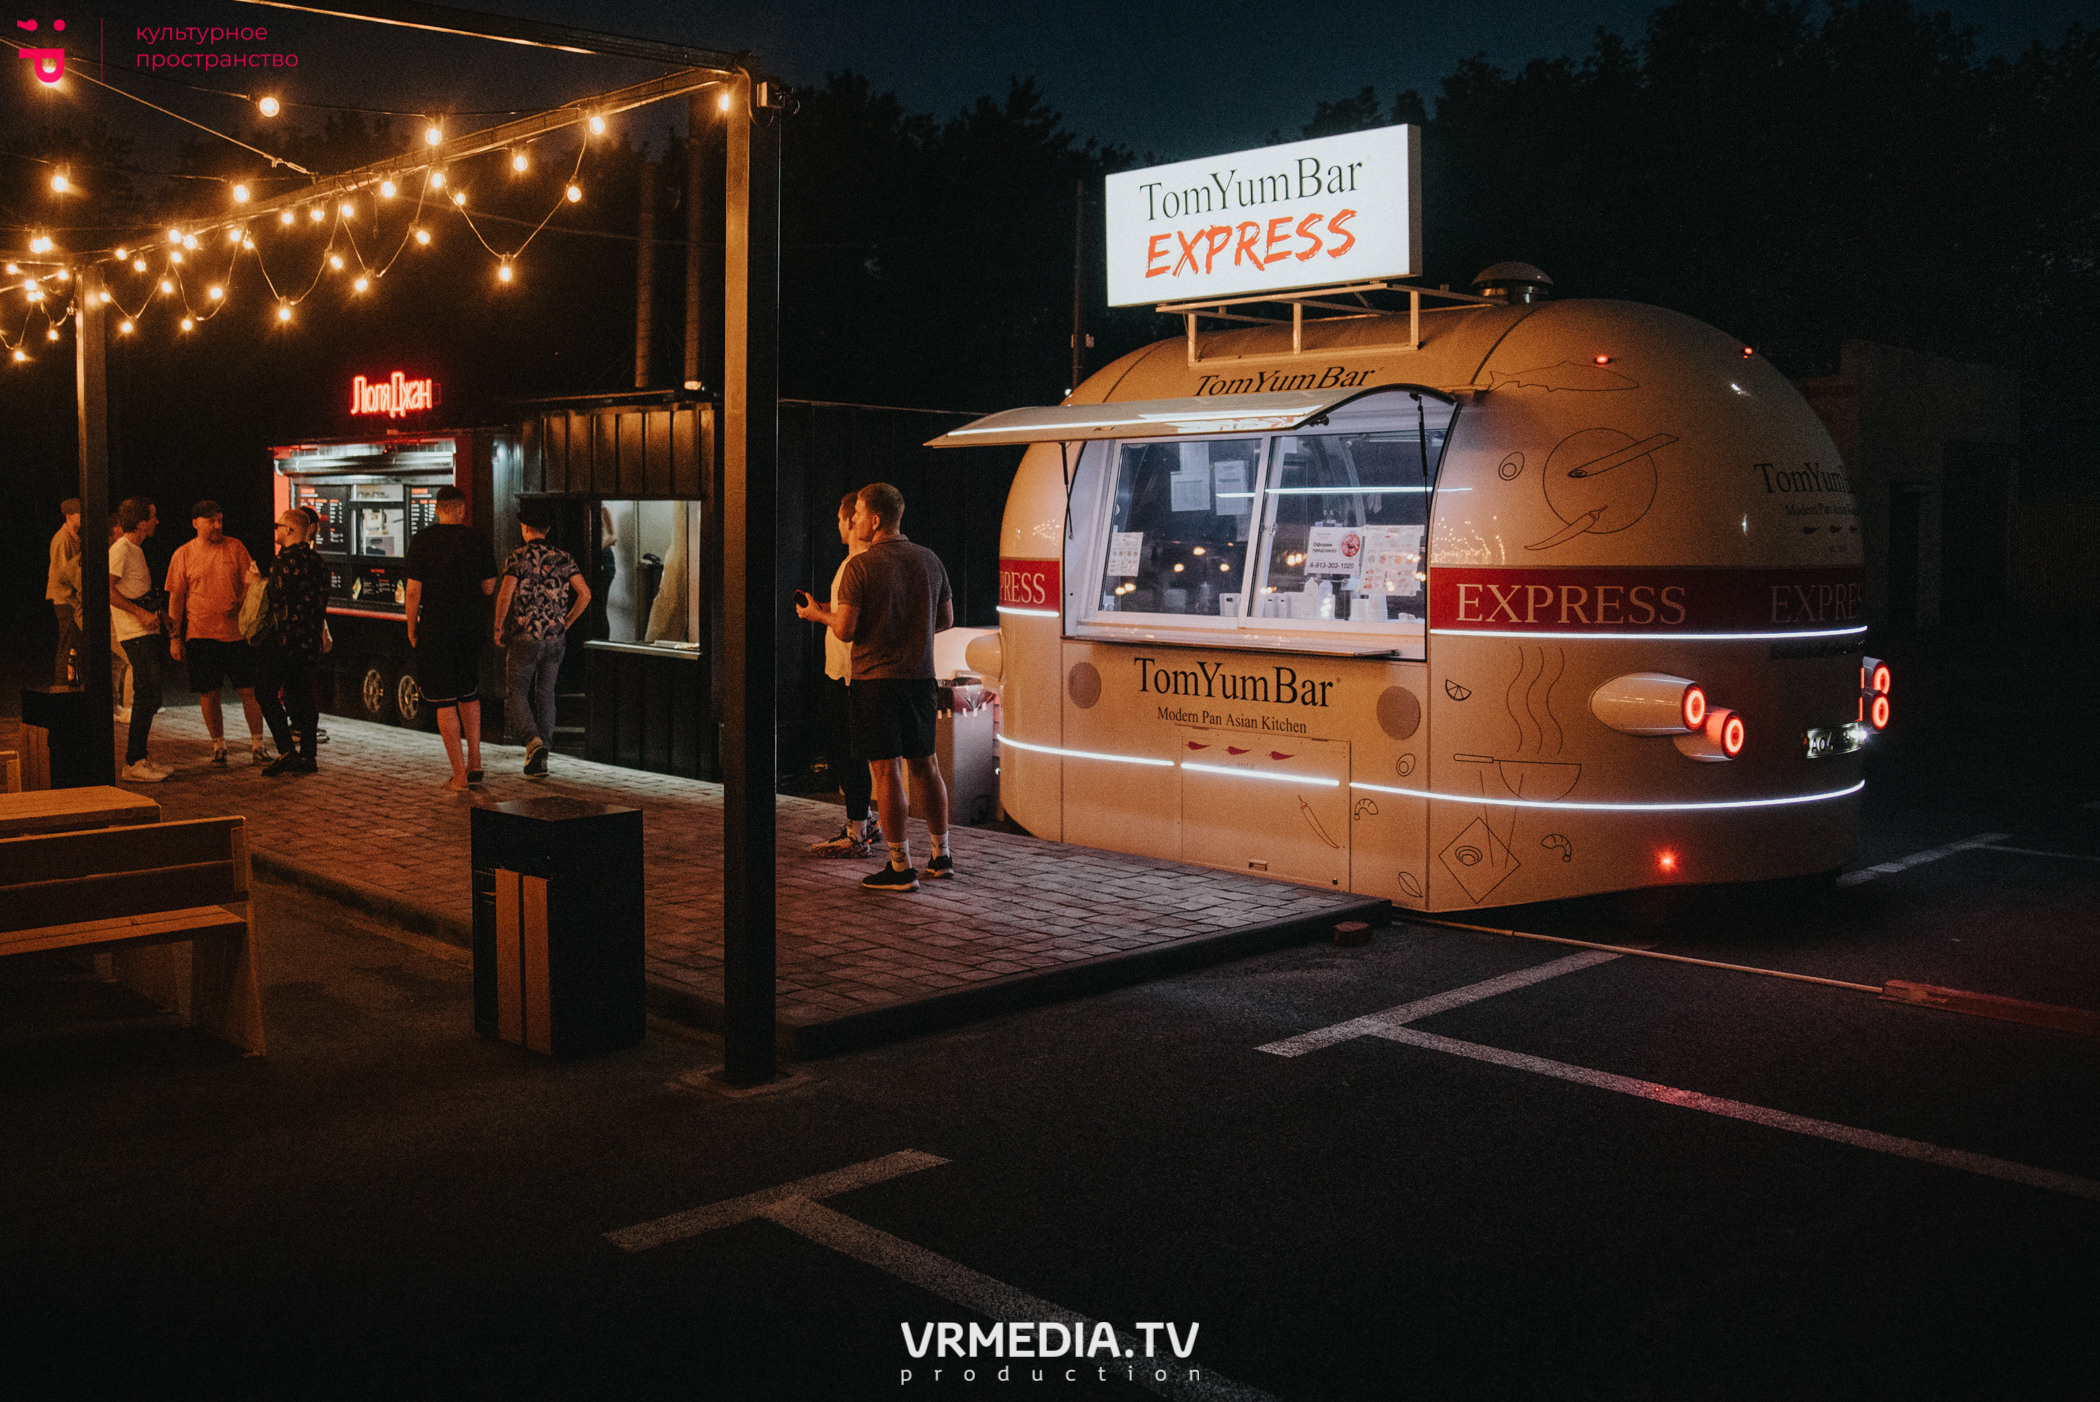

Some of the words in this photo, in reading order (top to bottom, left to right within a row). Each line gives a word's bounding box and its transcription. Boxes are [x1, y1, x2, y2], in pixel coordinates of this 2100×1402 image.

[1140, 157, 1363, 222] TomYumBar
[1145, 208, 1358, 278] EXPRESS
[1193, 366, 1376, 397] TomYumBar
[1456, 582, 1687, 625] EXPRESS
[1134, 656, 1334, 708] TomYumBar
[1157, 706, 1199, 723] Modern
[1202, 710, 1221, 726] Pan
[1225, 713, 1258, 729] Asian
[1261, 716, 1307, 734] Kitchen
